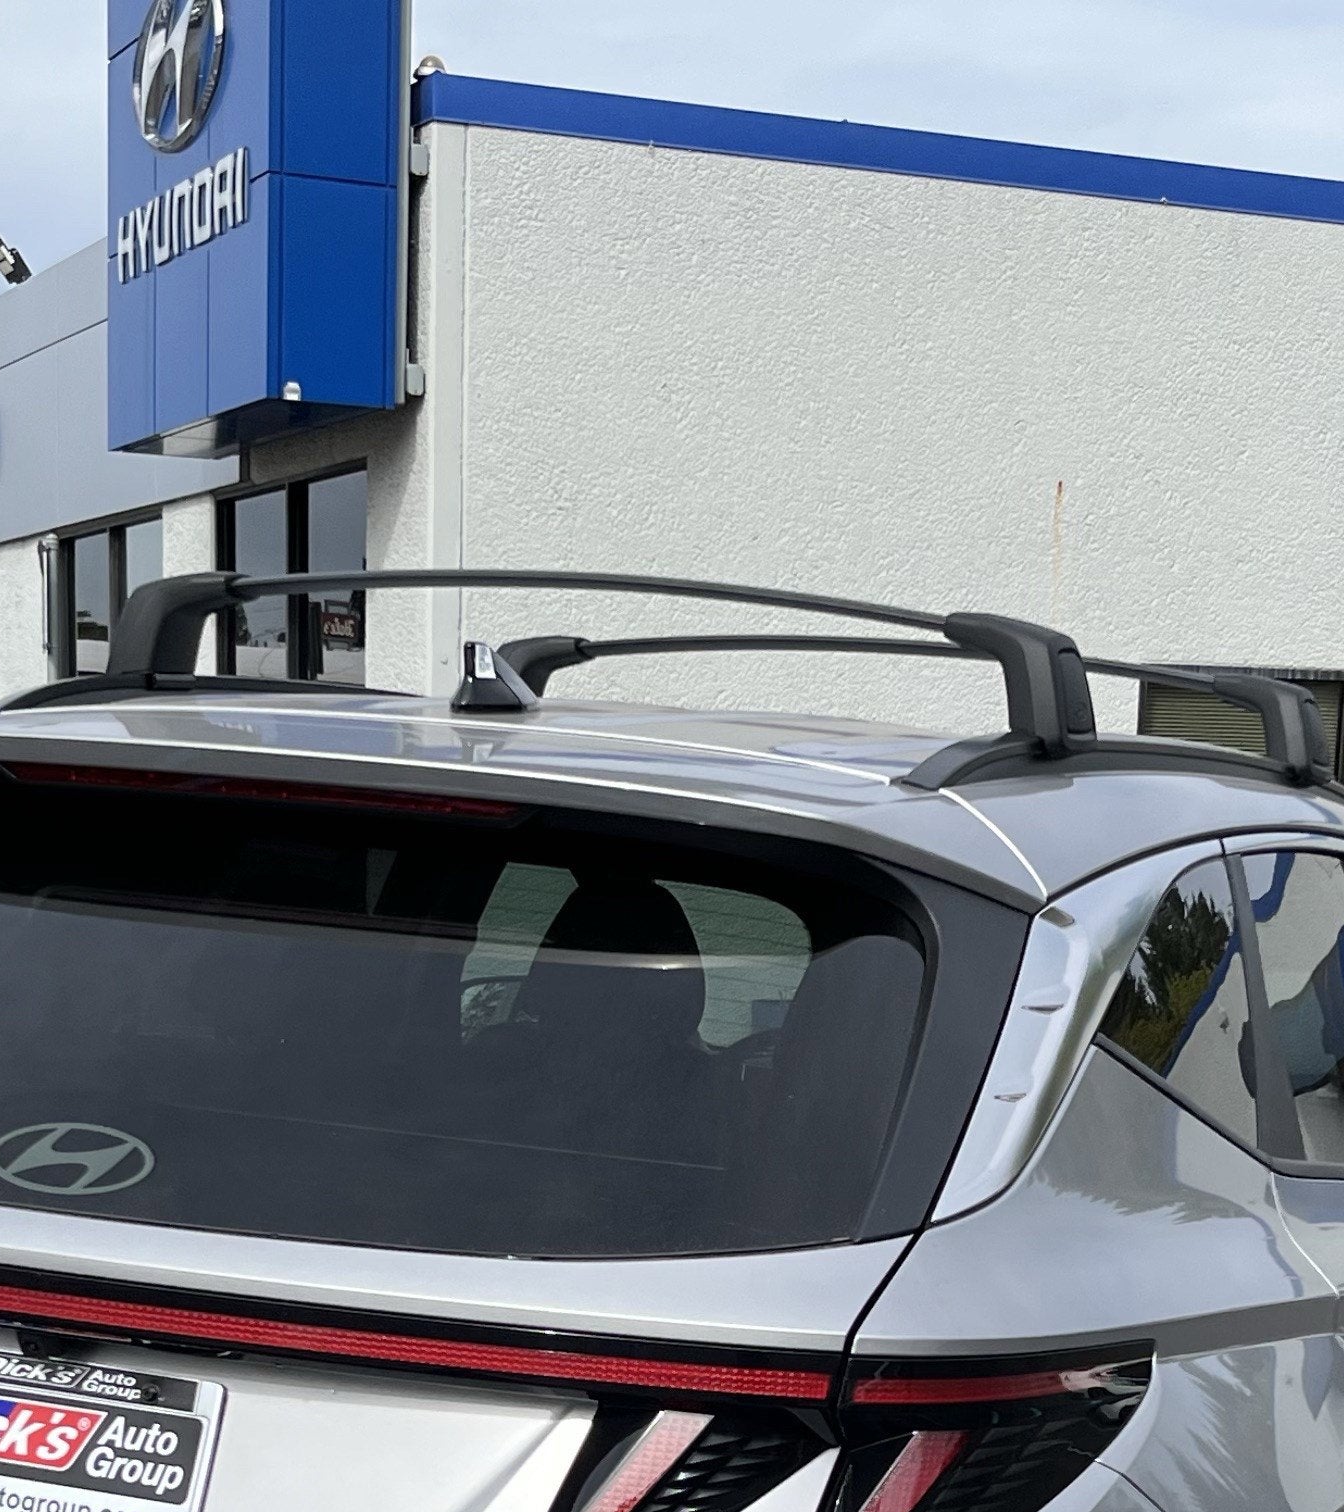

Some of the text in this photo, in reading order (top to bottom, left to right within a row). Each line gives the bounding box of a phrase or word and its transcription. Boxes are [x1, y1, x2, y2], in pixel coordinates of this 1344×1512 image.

[118, 146, 247, 285] HYUNDAI
[82, 1379, 142, 1401] Group
[89, 1368, 137, 1387] Auto
[97, 1415, 179, 1457] Auto
[85, 1447, 185, 1496] Group
